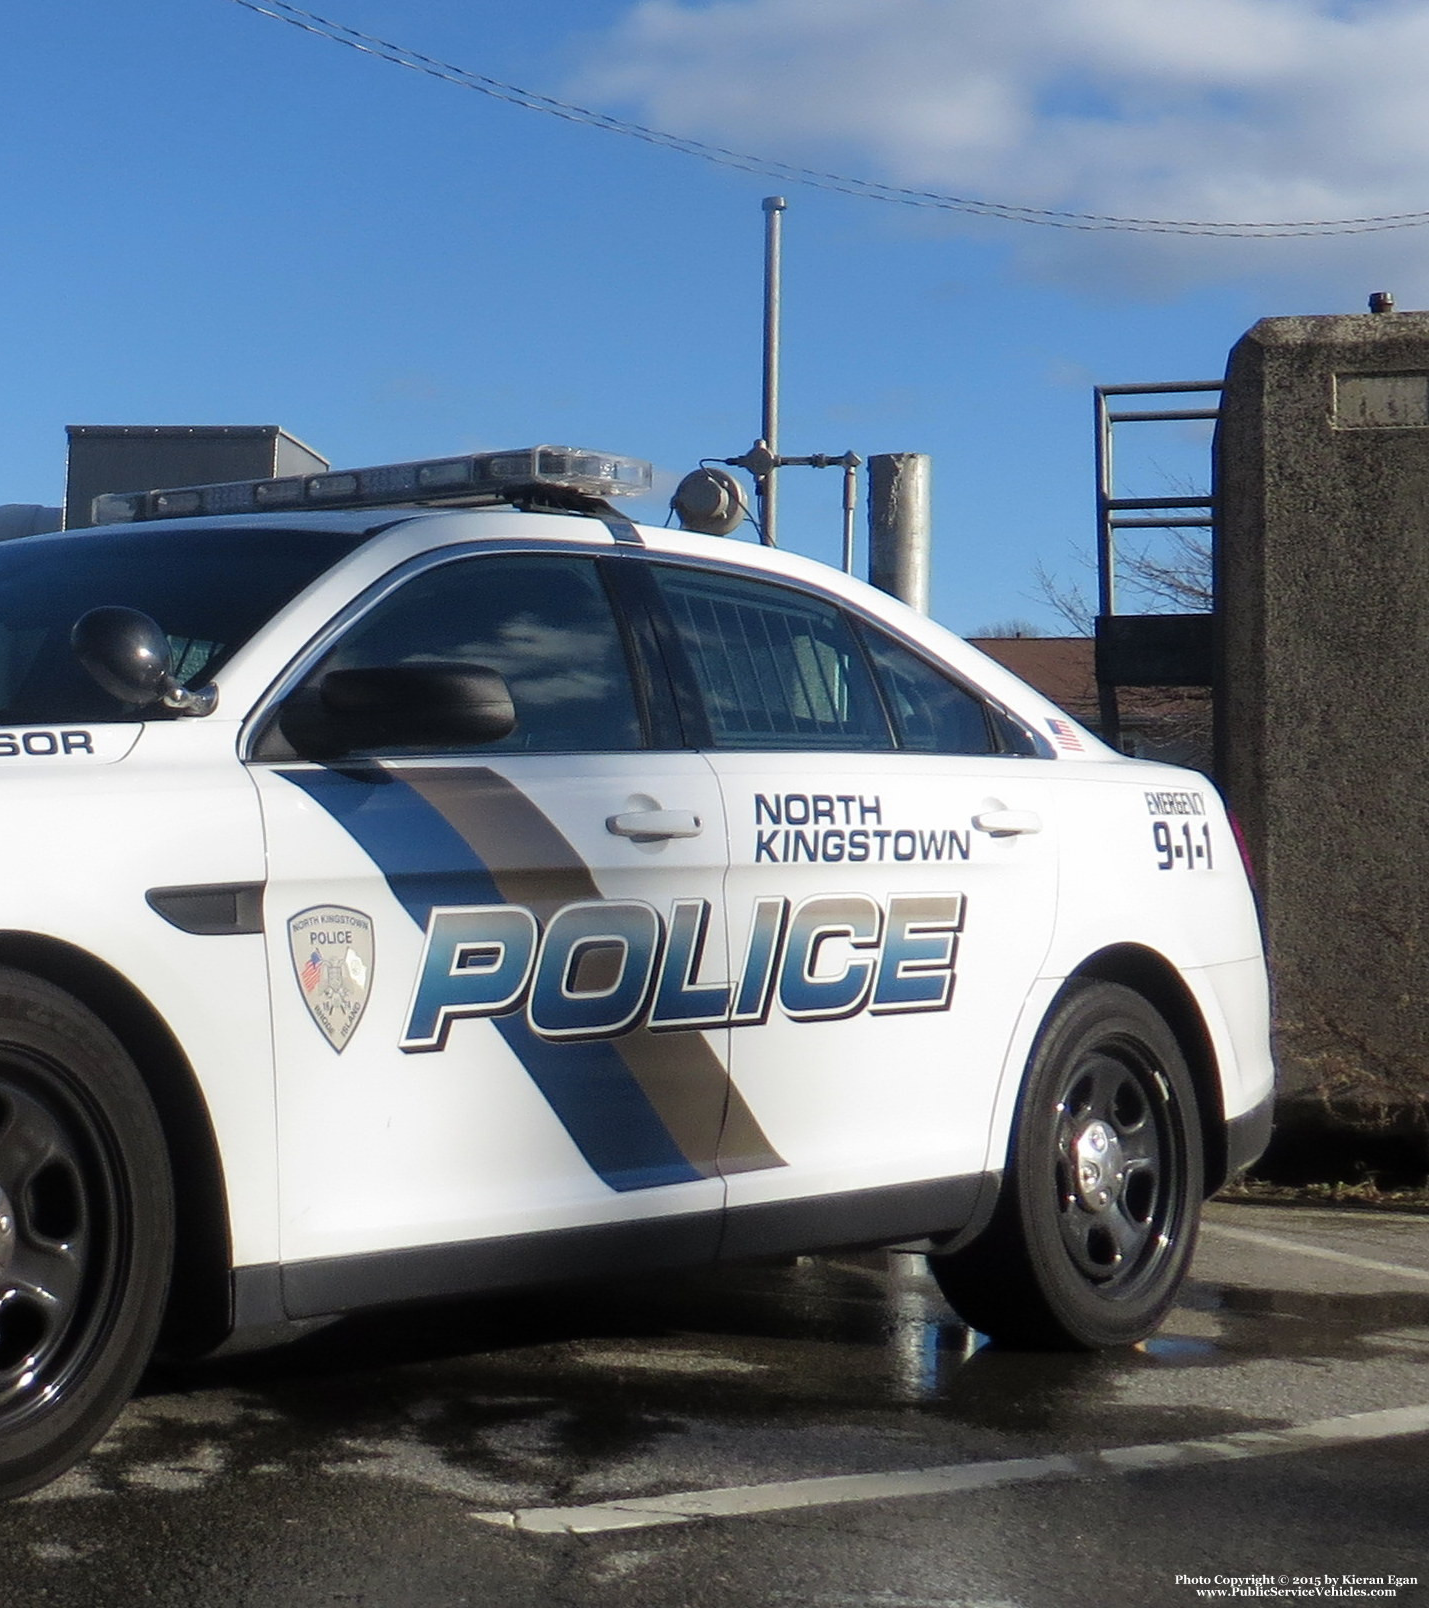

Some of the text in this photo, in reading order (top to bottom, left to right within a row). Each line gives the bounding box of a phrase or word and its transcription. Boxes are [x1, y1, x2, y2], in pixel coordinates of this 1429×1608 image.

[754, 794, 882, 825] NORTH
[1144, 792, 1206, 815] EMERGENCY
[755, 830, 971, 862] KINGSTOWN
[1153, 821, 1213, 870] 9-1-1
[292, 914, 369, 932] NORTH KINGSTOWN
[310, 931, 352, 945] POLICE
[398, 892, 968, 1053] POLICE
[340, 1001, 361, 1037] ISLAND
